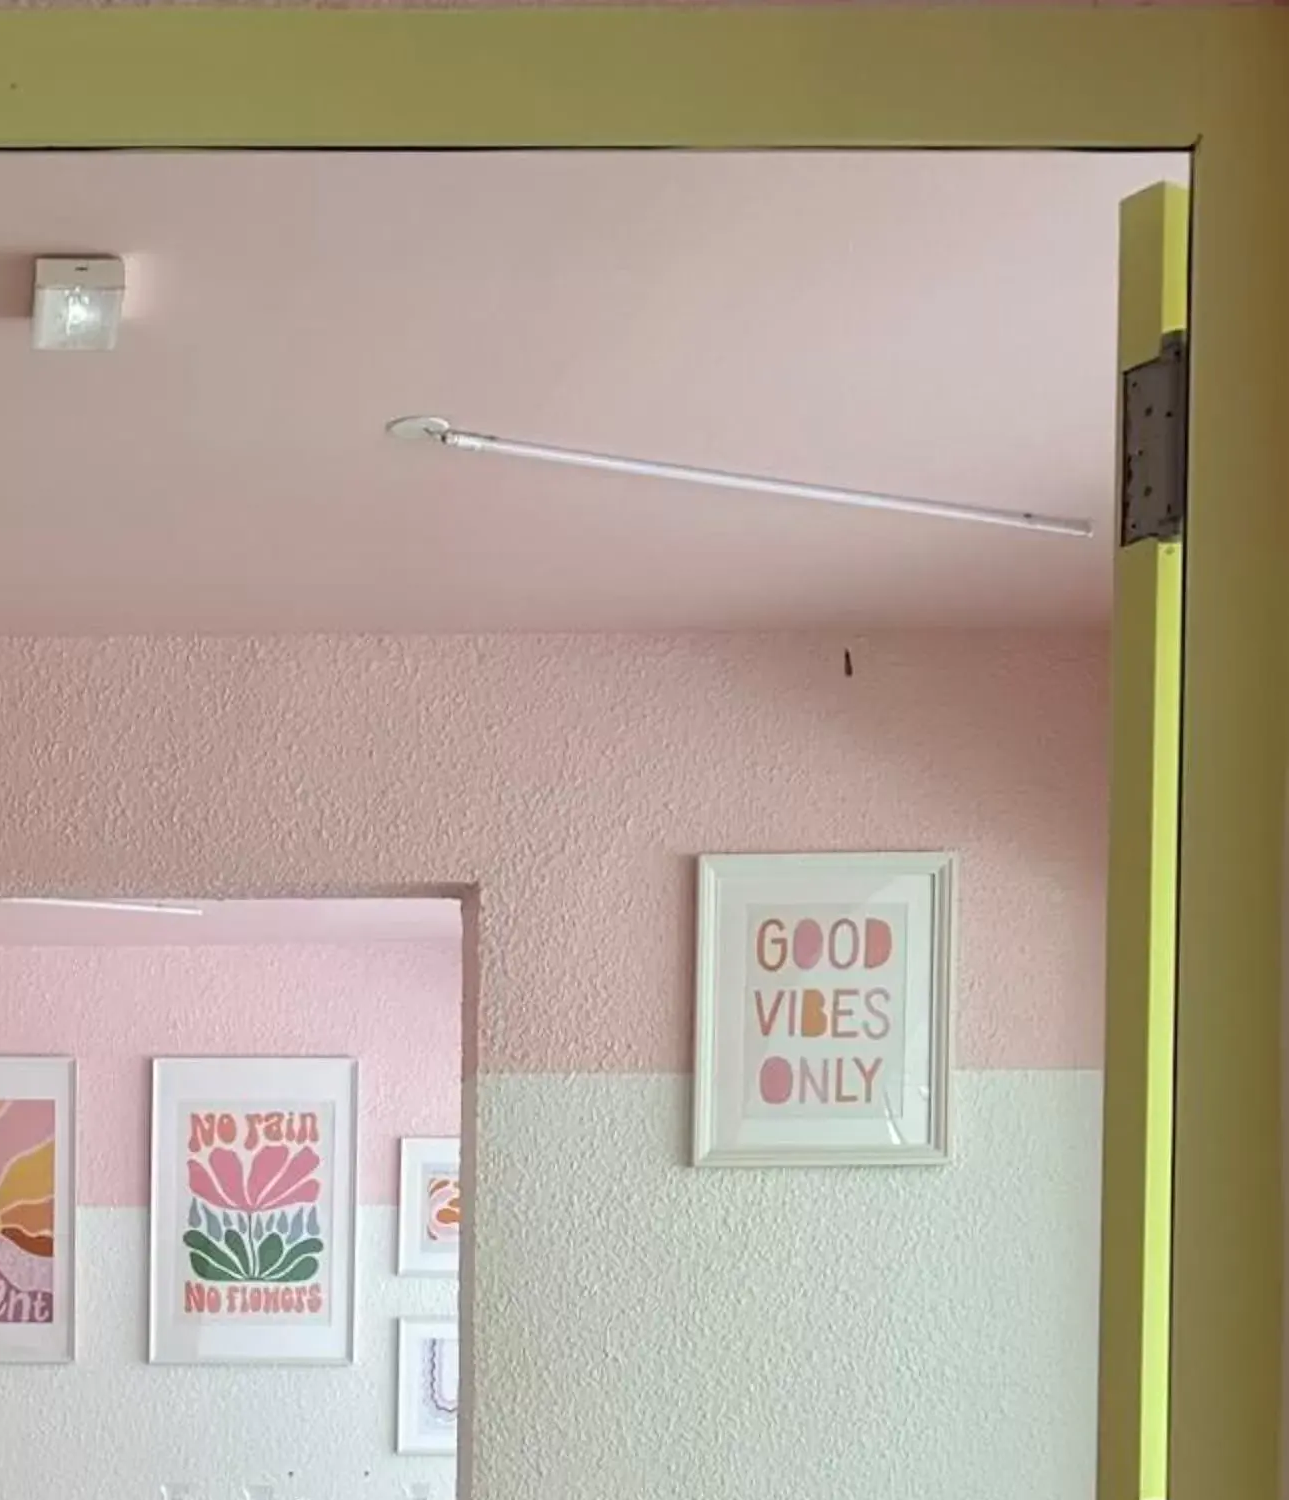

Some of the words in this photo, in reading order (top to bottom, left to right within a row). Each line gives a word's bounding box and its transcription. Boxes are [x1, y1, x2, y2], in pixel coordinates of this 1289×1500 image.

[756, 917, 893, 972] GOOD
[754, 987, 890, 1041] VIBES
[759, 1056, 883, 1104] ONLY
[244, 1111, 320, 1151] rain
[226, 1281, 323, 1314] flowers
